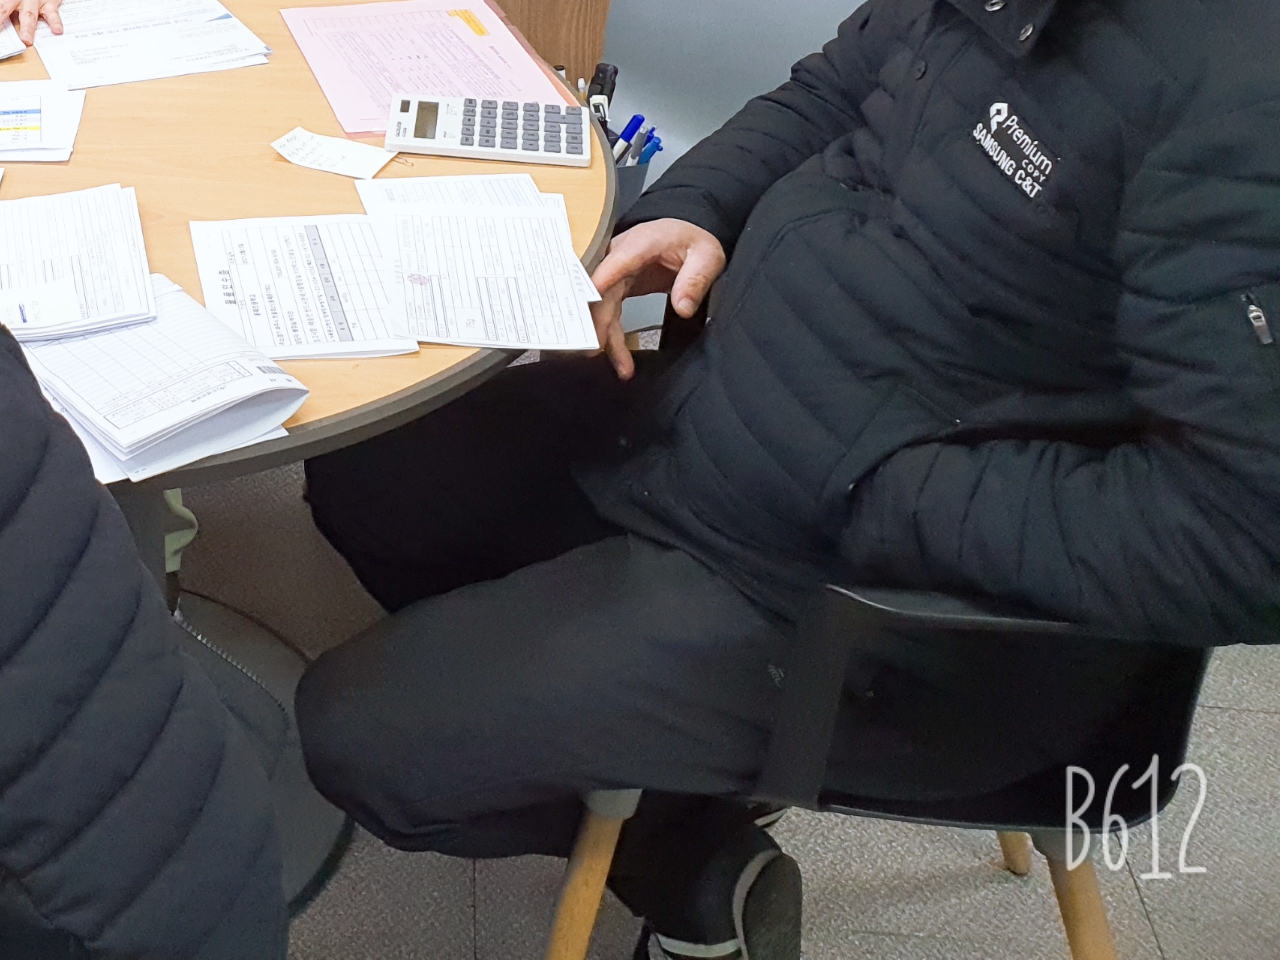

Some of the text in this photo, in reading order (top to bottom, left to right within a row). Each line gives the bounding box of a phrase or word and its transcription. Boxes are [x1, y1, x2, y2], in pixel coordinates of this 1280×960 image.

[972, 122, 1043, 198] SAMSUNG C&T
[1002, 115, 1053, 175] Premium
[1021, 159, 1046, 183] COPY
